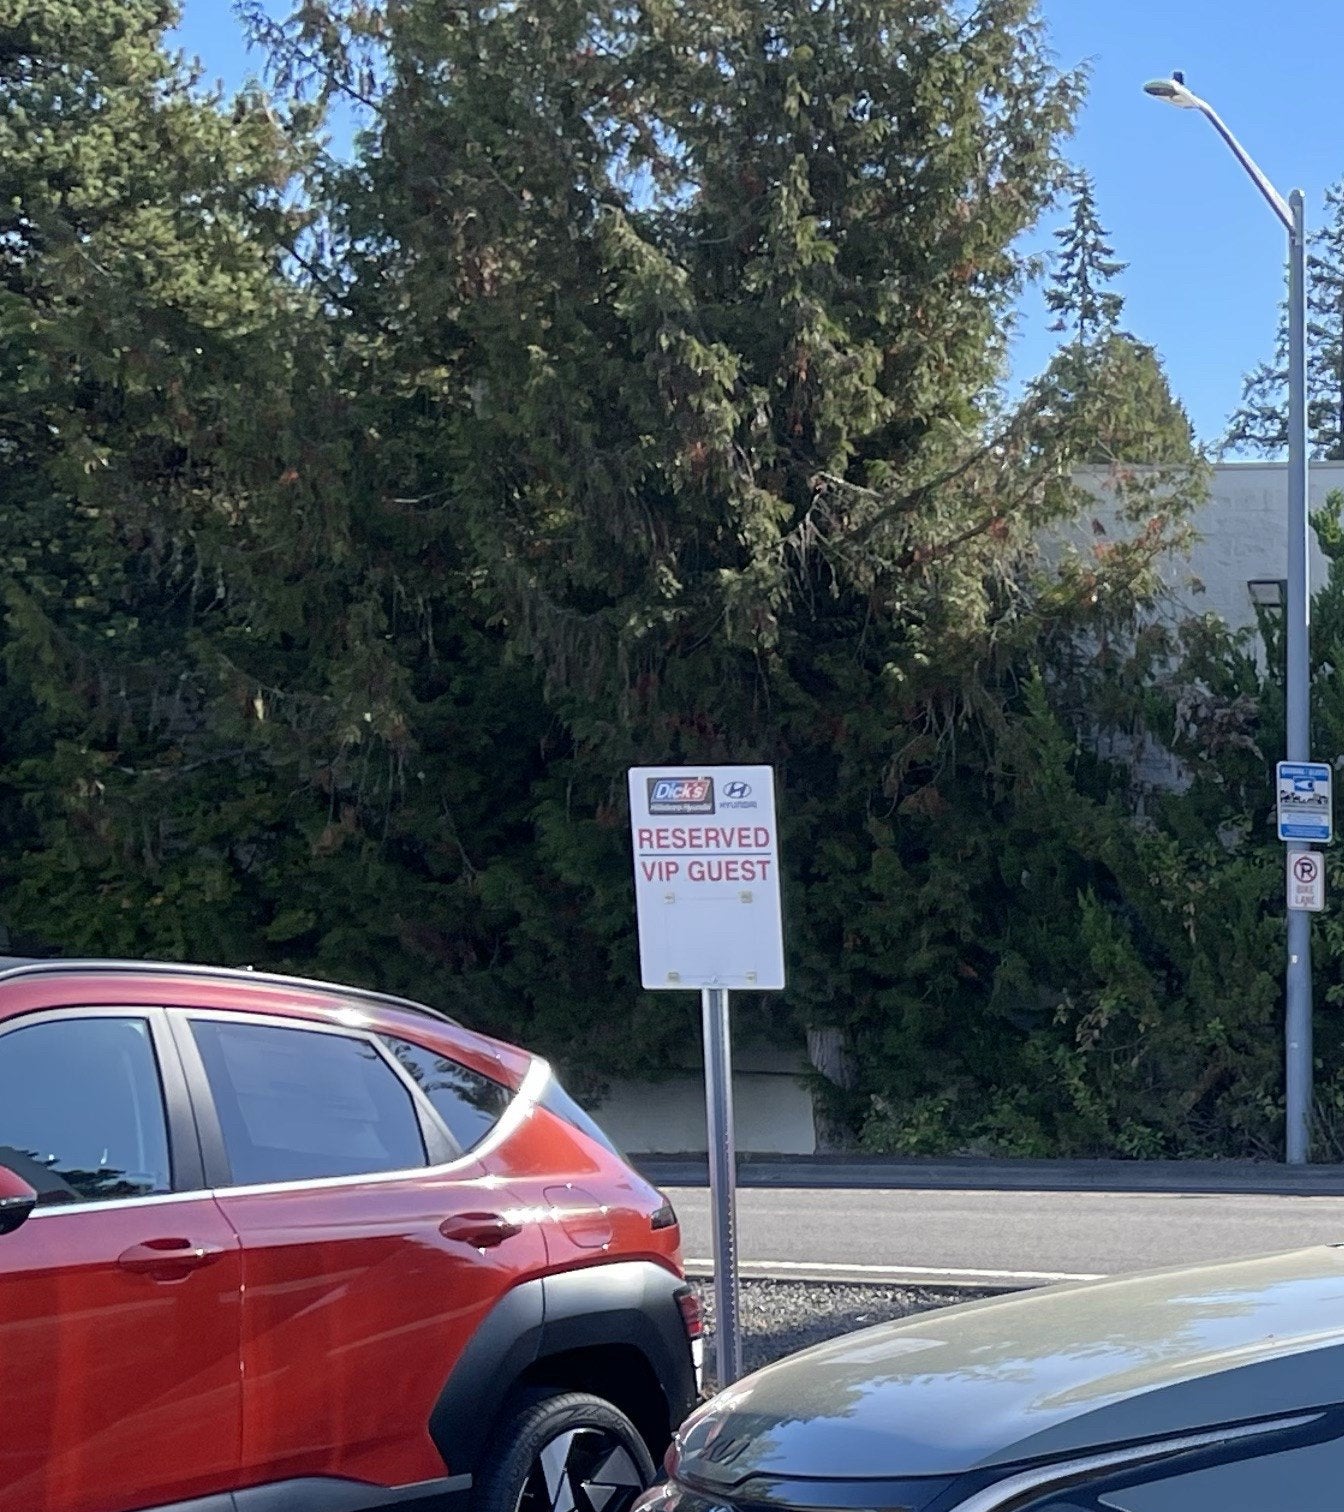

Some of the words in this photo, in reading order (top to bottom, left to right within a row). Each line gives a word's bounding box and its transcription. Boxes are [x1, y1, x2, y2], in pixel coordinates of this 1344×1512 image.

[638, 826, 770, 850] RESERVED
[641, 860, 680, 882] VIP
[687, 859, 771, 882] GUEST
